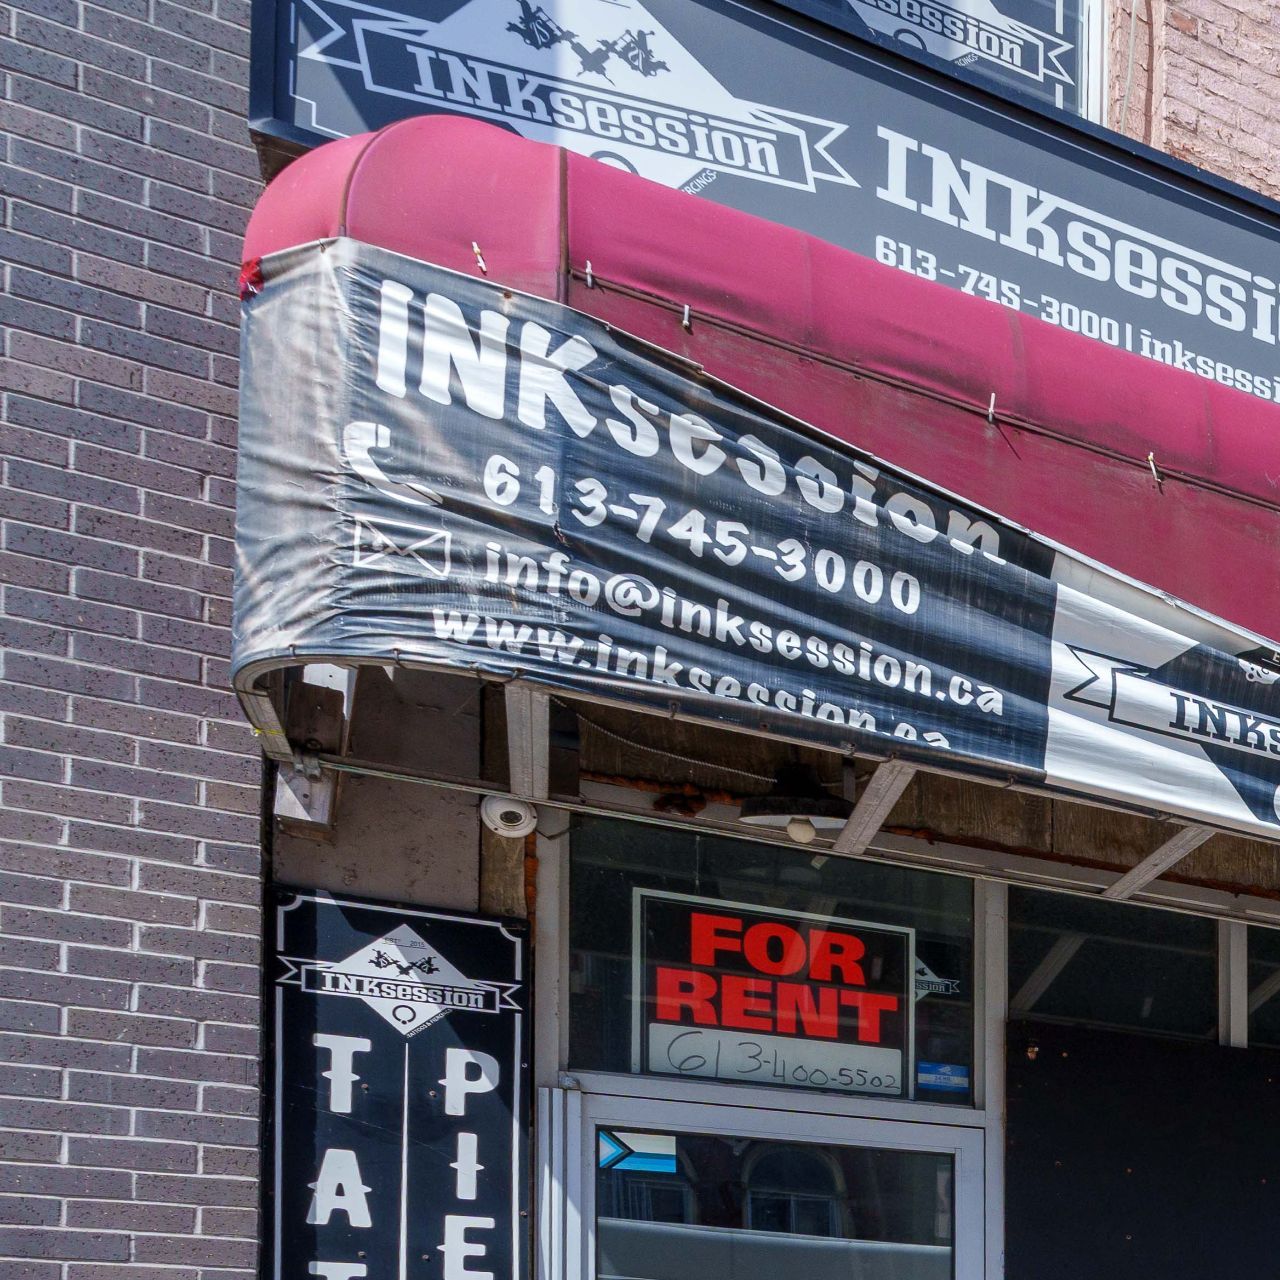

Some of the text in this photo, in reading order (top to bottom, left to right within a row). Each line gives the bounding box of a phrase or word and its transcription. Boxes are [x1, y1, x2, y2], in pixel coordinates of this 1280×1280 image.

[406, 44, 779, 176] INKsession
[875, 234, 1119, 346] 613-745-3000
[376, 278, 1007, 566] INKsession
[482, 454, 923, 616] 613-745-3000
[484, 542, 1005, 717] info@inksession.ca
[321, 972, 486, 1009] INKsession
[655, 966, 898, 1043] RENT
[690, 911, 867, 987] FOR
[666, 1030, 901, 1091] 613-400-5502
